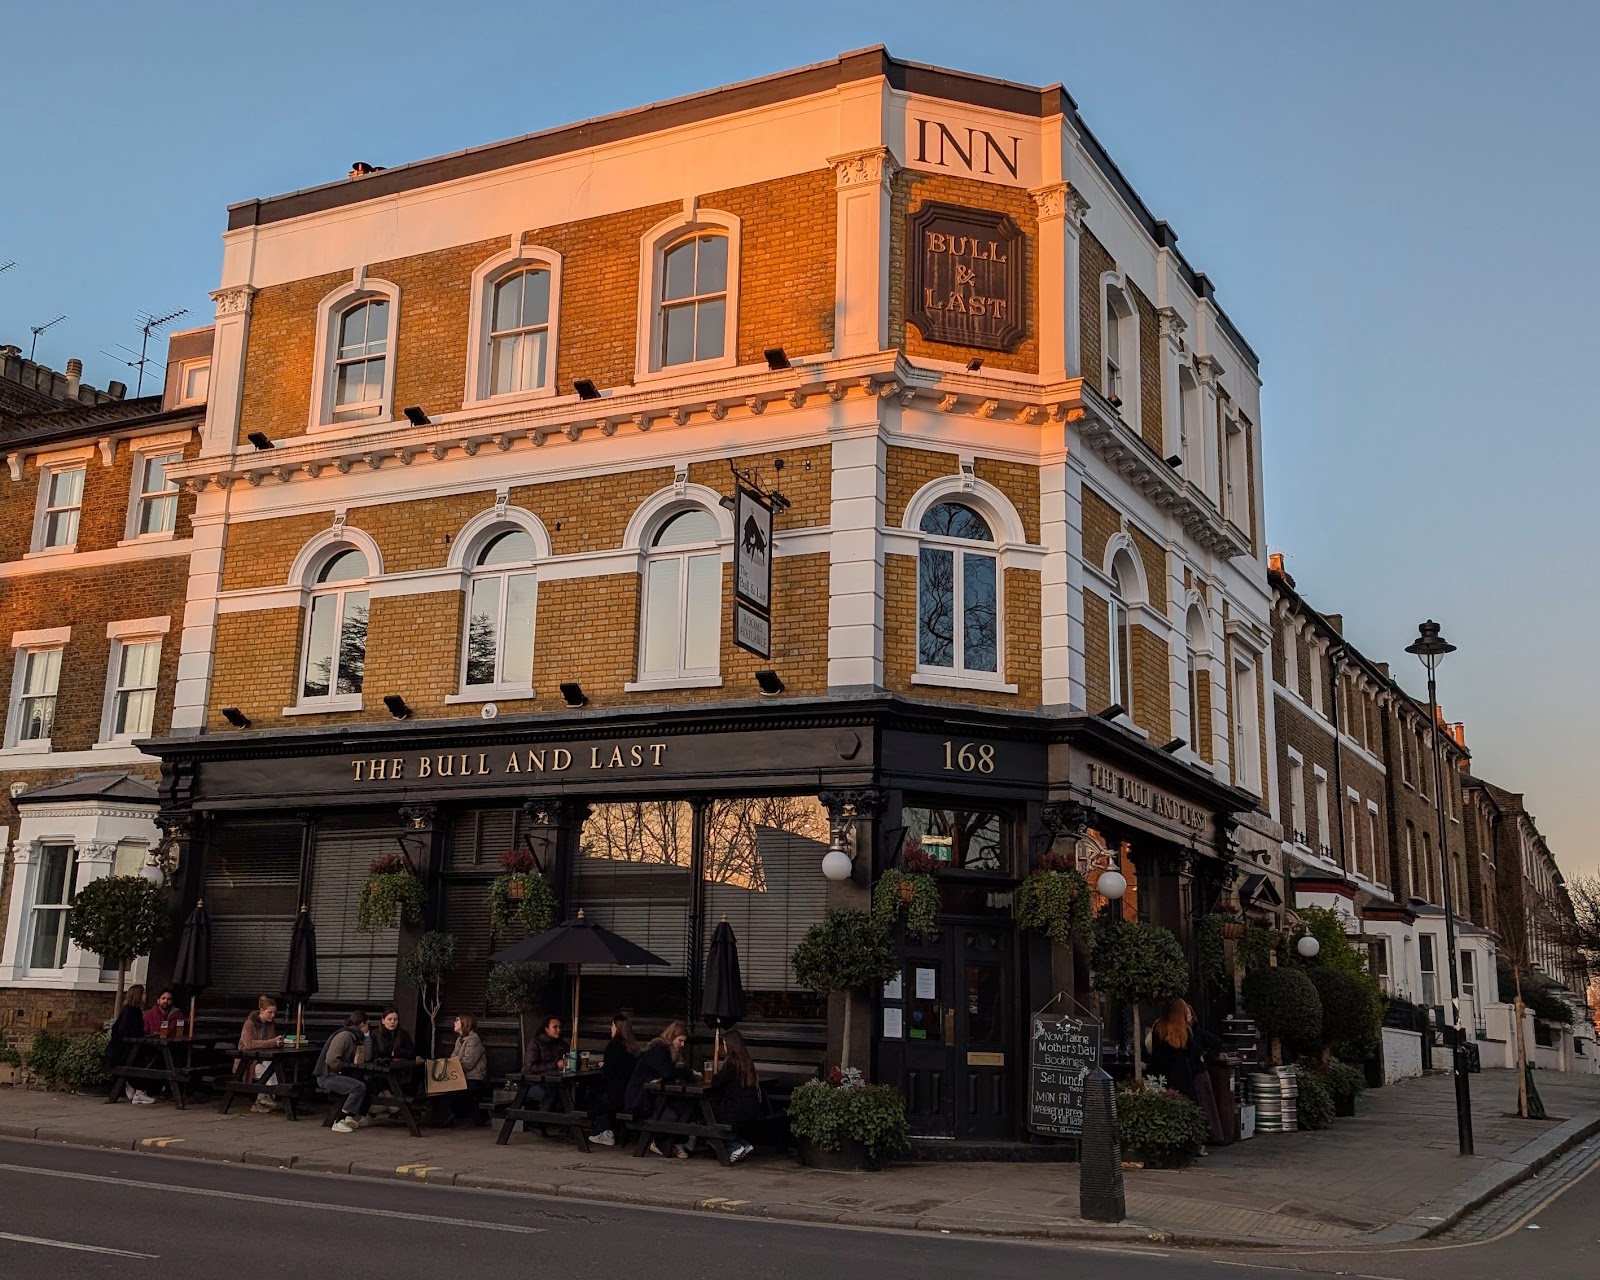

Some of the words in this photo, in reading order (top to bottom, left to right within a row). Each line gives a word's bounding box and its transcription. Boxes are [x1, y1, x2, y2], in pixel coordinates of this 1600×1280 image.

[913, 117, 1022, 180] INN
[926, 230, 1008, 264] BULL
[955, 264, 977, 287] &
[924, 286, 1007, 320] LAST
[739, 564, 749, 578] The
[739, 577, 750, 592] Bull
[750, 584, 756, 597] &
[756, 587, 767, 603] Last
[743, 614, 763, 633] ROOMS
[740, 626, 767, 649] AVAILABLE
[352, 757, 404, 781] THE
[418, 753, 491, 778] BULL
[505, 748, 573, 773] AND
[590, 743, 667, 769] LAST
[942, 740, 996, 774] 168
[1091, 762, 1118, 794] THE
[1123, 778, 1152, 809] BULL
[1157, 792, 1181, 820] AND
[1183, 803, 1209, 832] LAST
[1044, 1031, 1064, 1041] Now
[1064, 1032, 1089, 1044] Taking
[1044, 1054, 1085, 1067] Bookings
[1077, 1044, 1096, 1062] Day
[1040, 1071, 1056, 1084] Set
[1059, 1073, 1084, 1086] lunch
[1036, 1091, 1056, 1103] MON
[1058, 1093, 1071, 1104] FRI
